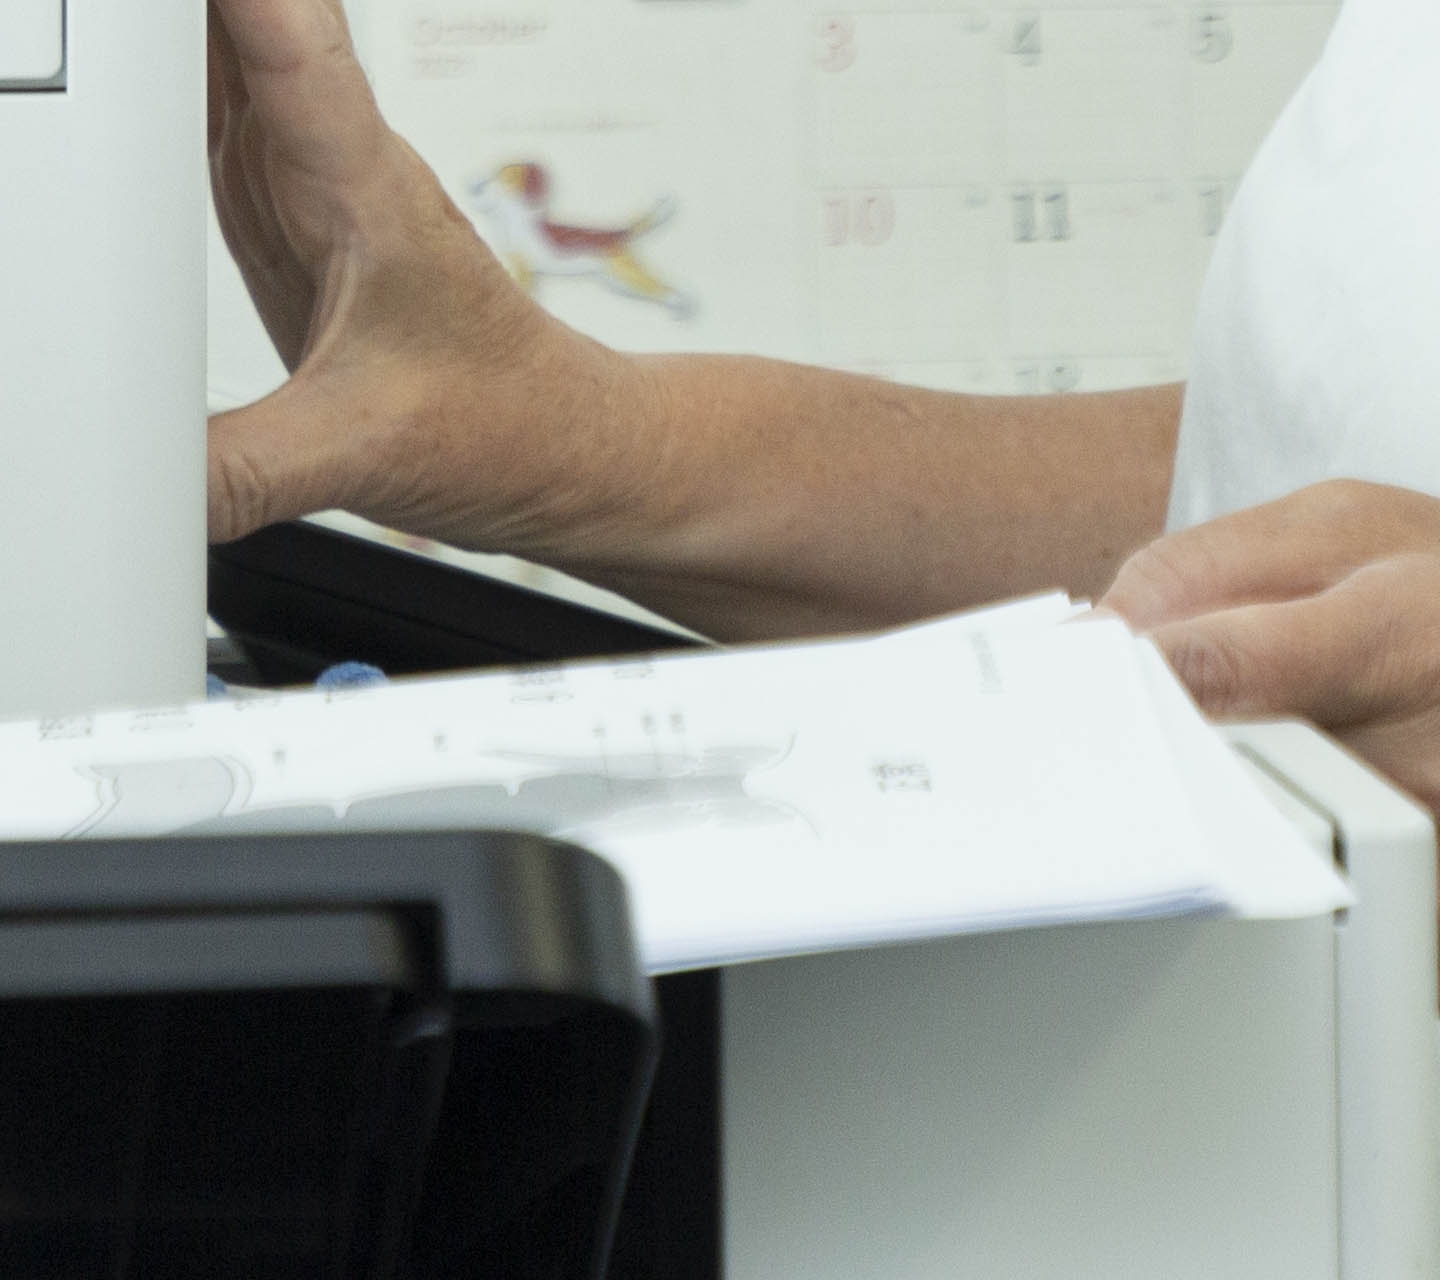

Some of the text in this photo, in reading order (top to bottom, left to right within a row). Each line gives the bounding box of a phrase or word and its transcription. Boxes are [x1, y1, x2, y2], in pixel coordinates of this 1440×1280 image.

[814, 6, 1233, 73] 3 4 5
[823, 186, 896, 248] 10
[1010, 184, 1071, 244] 11
